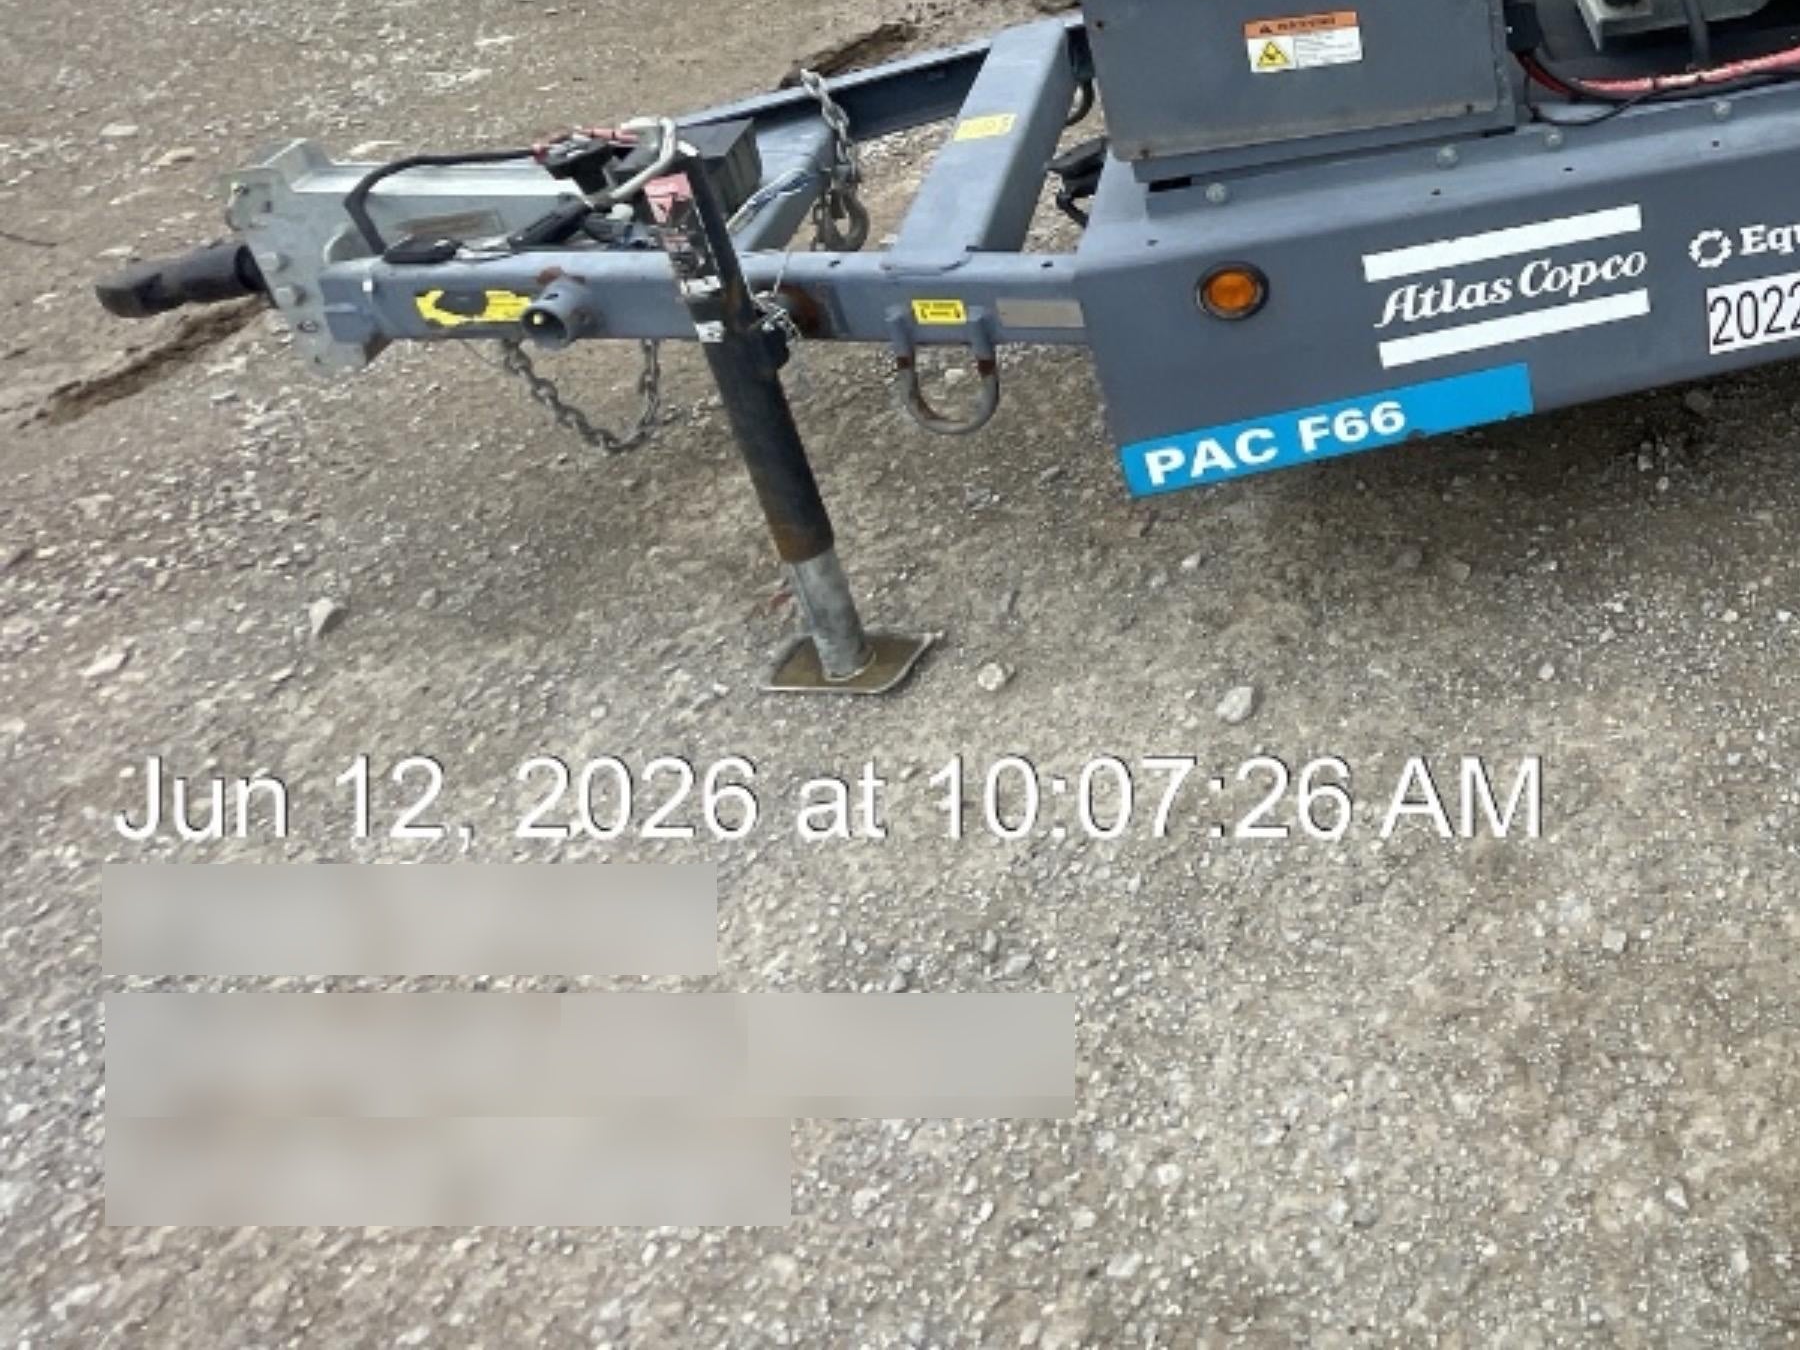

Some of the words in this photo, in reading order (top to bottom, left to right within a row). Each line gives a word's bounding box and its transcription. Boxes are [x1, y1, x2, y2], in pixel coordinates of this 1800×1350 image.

[1373, 277, 1513, 328] Atlas
[1518, 252, 1648, 298] Copco
[1144, 428, 1279, 487] PAC
[1298, 400, 1406, 453] F66
